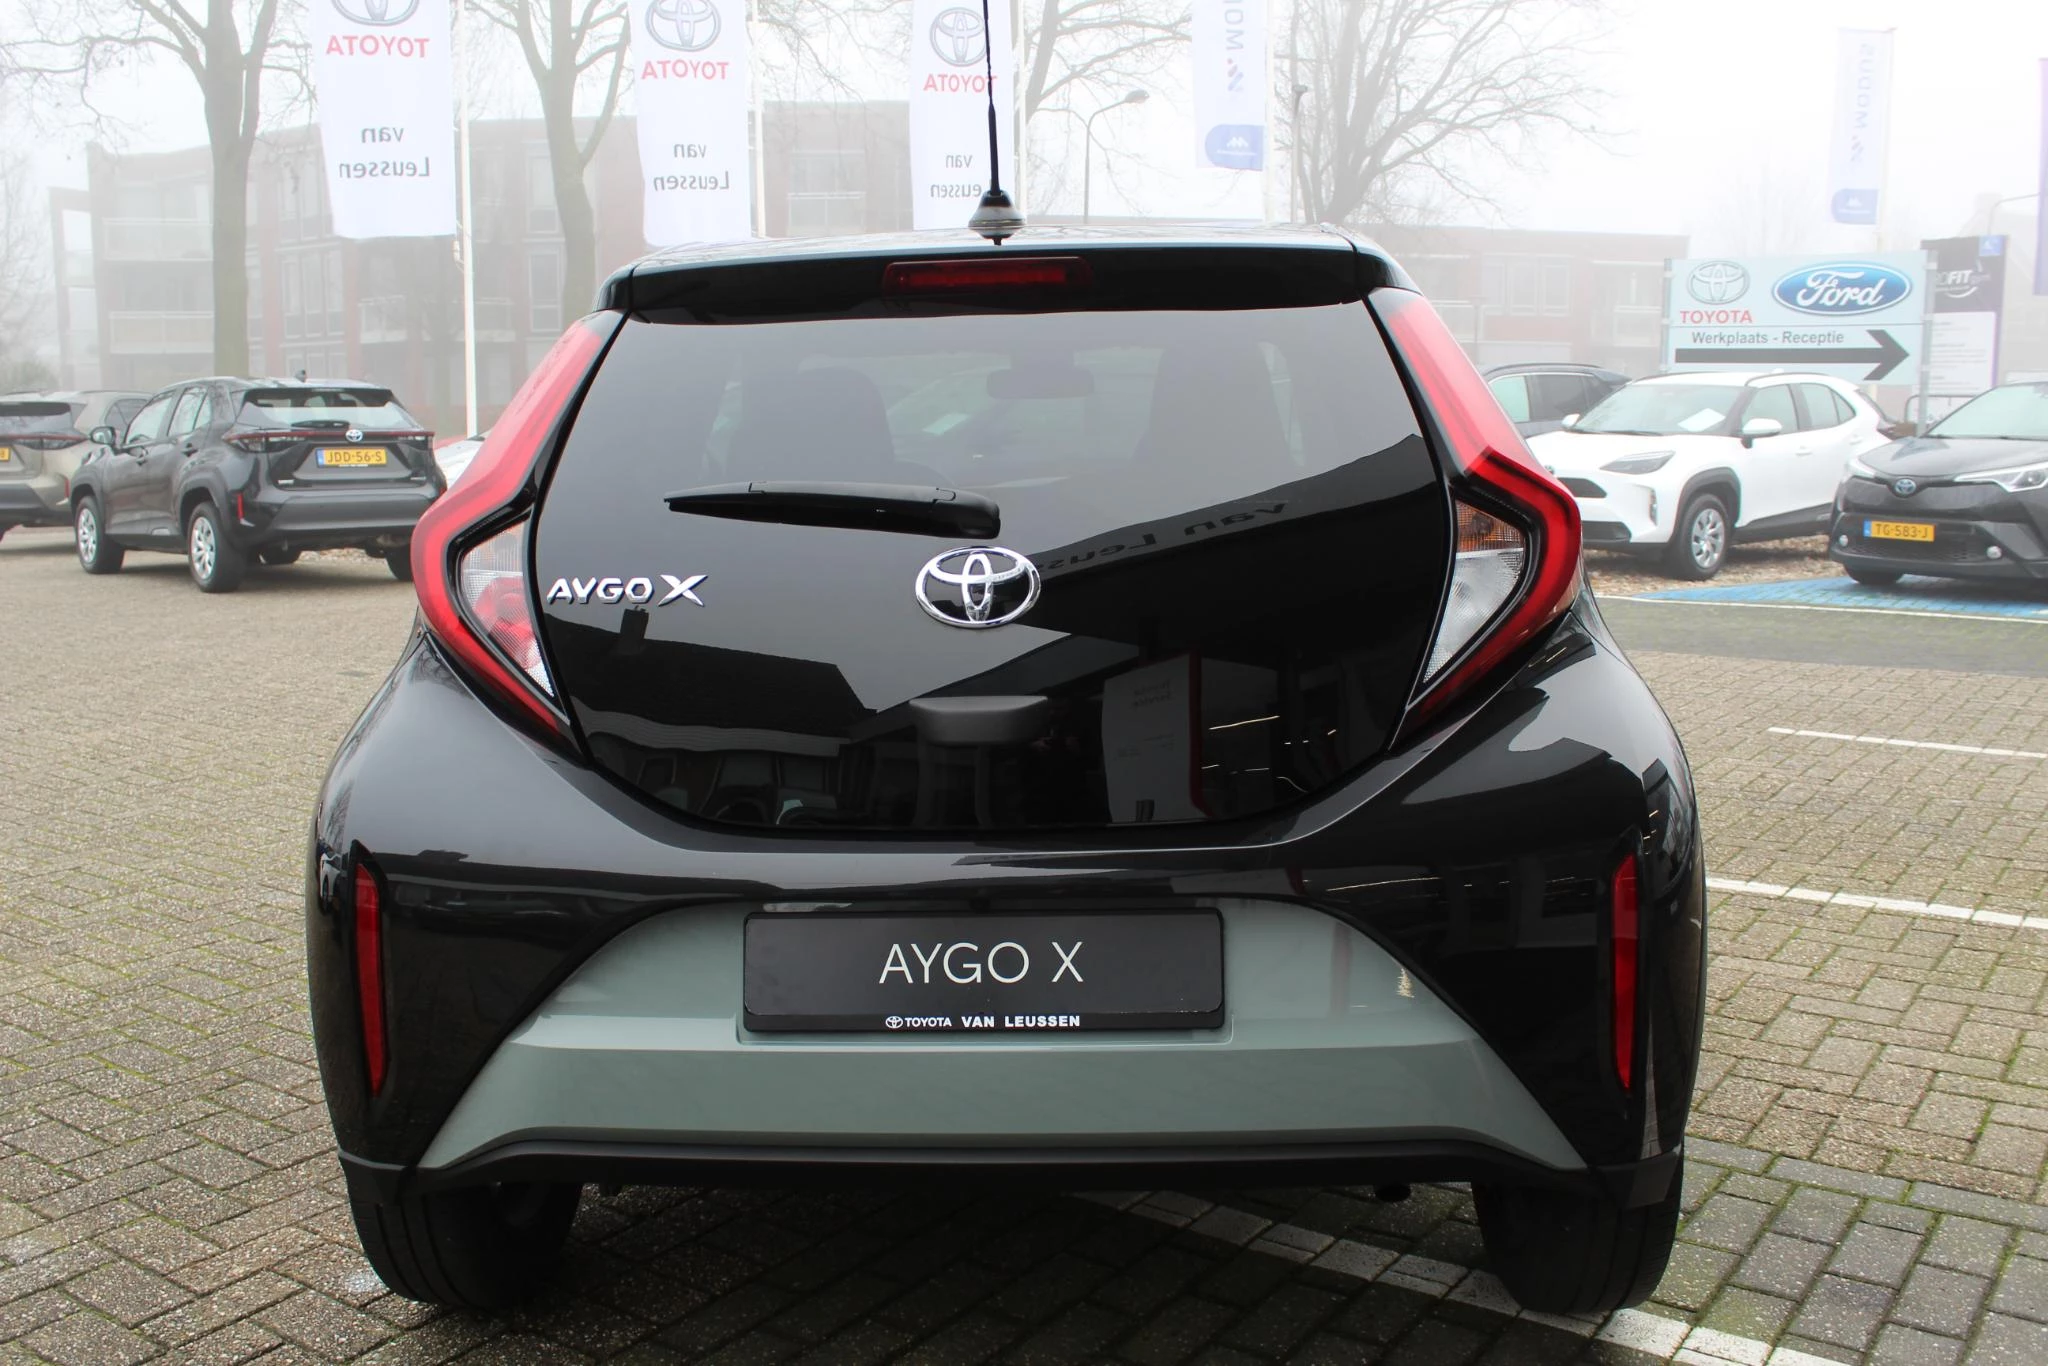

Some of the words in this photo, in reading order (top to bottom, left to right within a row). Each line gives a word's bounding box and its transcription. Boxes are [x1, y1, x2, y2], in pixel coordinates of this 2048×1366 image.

[1796, 269, 1887, 307] Ford
[1680, 310, 1753, 324] TOYOTA
[1691, 331, 1769, 345] Werkplaats
[1782, 331, 1844, 346] Receptie
[327, 450, 383, 463] JDD-56-S
[1876, 523, 1928, 538] TG-583-J
[546, 577, 654, 606] AYGO
[658, 574, 708, 607] X
[878, 942, 1029, 983] AYGO
[1052, 941, 1084, 981] X
[904, 1017, 952, 1028] TOYOTA
[961, 1016, 995, 1028] VAN
[1005, 1016, 1081, 1028] LEUSSEN
